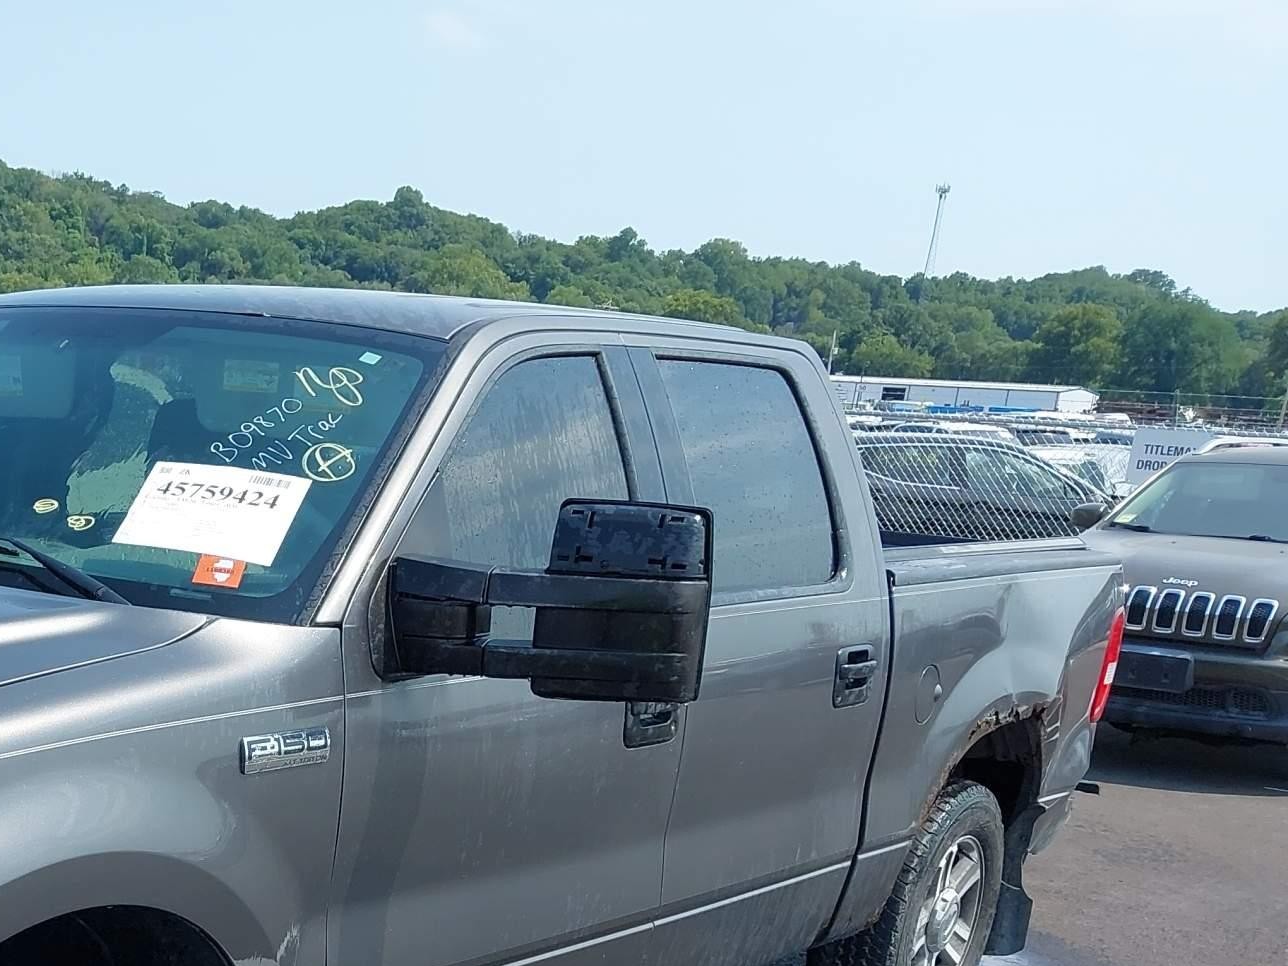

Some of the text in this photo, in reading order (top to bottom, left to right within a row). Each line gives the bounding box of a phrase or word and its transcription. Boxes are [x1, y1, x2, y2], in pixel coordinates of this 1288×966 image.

[251, 440, 293, 470] MV
[1144, 443, 1196, 456] TITLEMA
[156, 480, 281, 510] 45759424
[1162, 576, 1199, 588] Jeep
